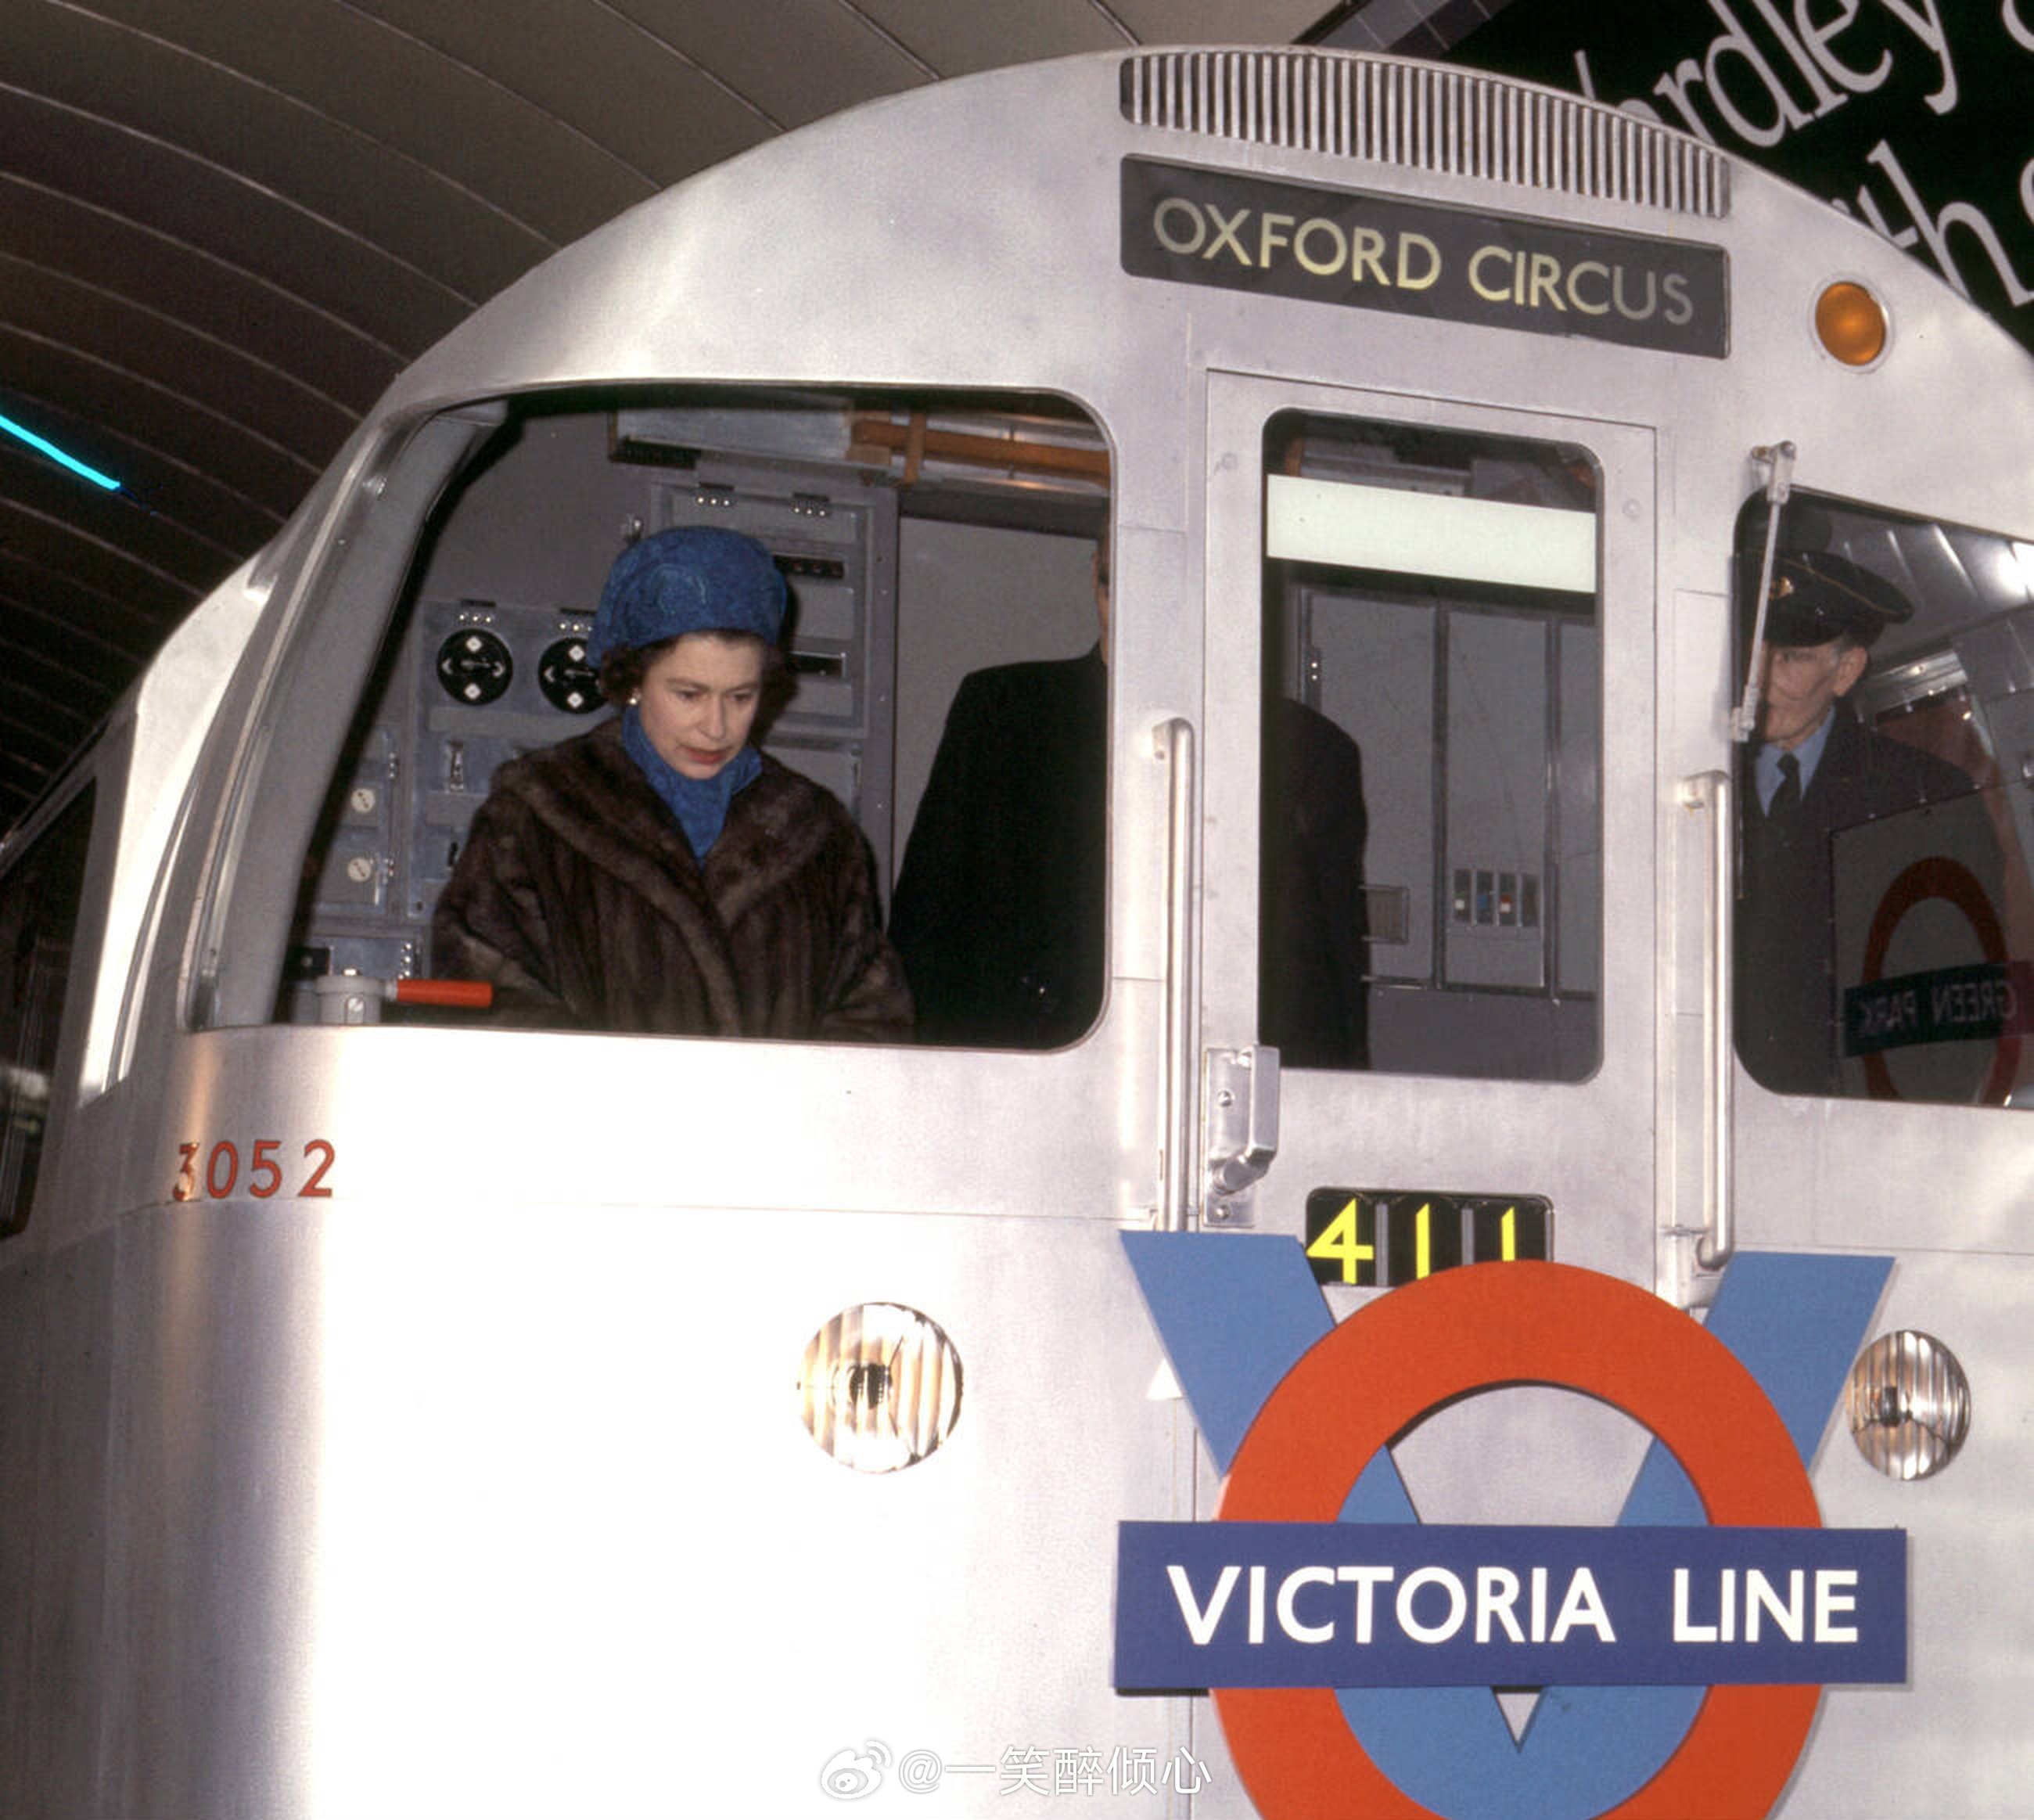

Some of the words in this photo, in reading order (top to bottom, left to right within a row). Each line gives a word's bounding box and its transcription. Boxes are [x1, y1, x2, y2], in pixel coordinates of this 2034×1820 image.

[1153, 197, 1442, 290] OXFORD
[1468, 244, 1694, 326] CIRCUS
[172, 1138, 336, 1203] 3052
[1166, 1565, 1617, 1646] VICTORIA
[1672, 1568, 1859, 1644] LINE
